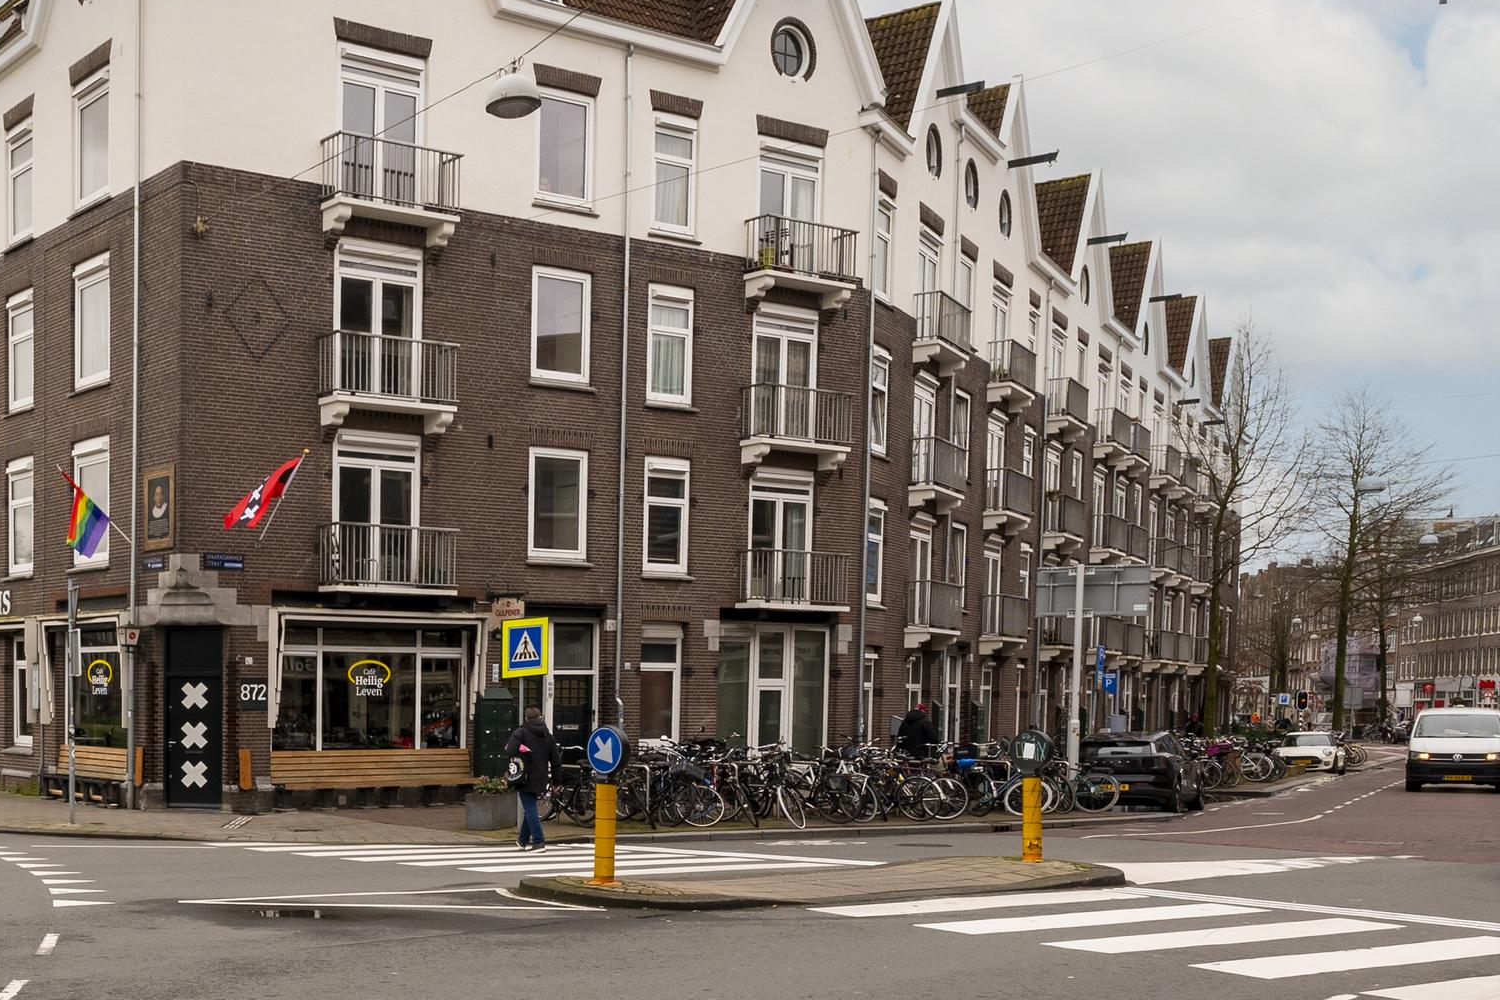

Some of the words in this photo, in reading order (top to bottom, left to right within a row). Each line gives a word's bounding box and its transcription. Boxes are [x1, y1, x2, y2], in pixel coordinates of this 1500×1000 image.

[363, 668, 376, 676] Café
[355, 676, 384, 688] Heilig
[240, 684, 267, 701] 872
[356, 687, 383, 696] Leven
